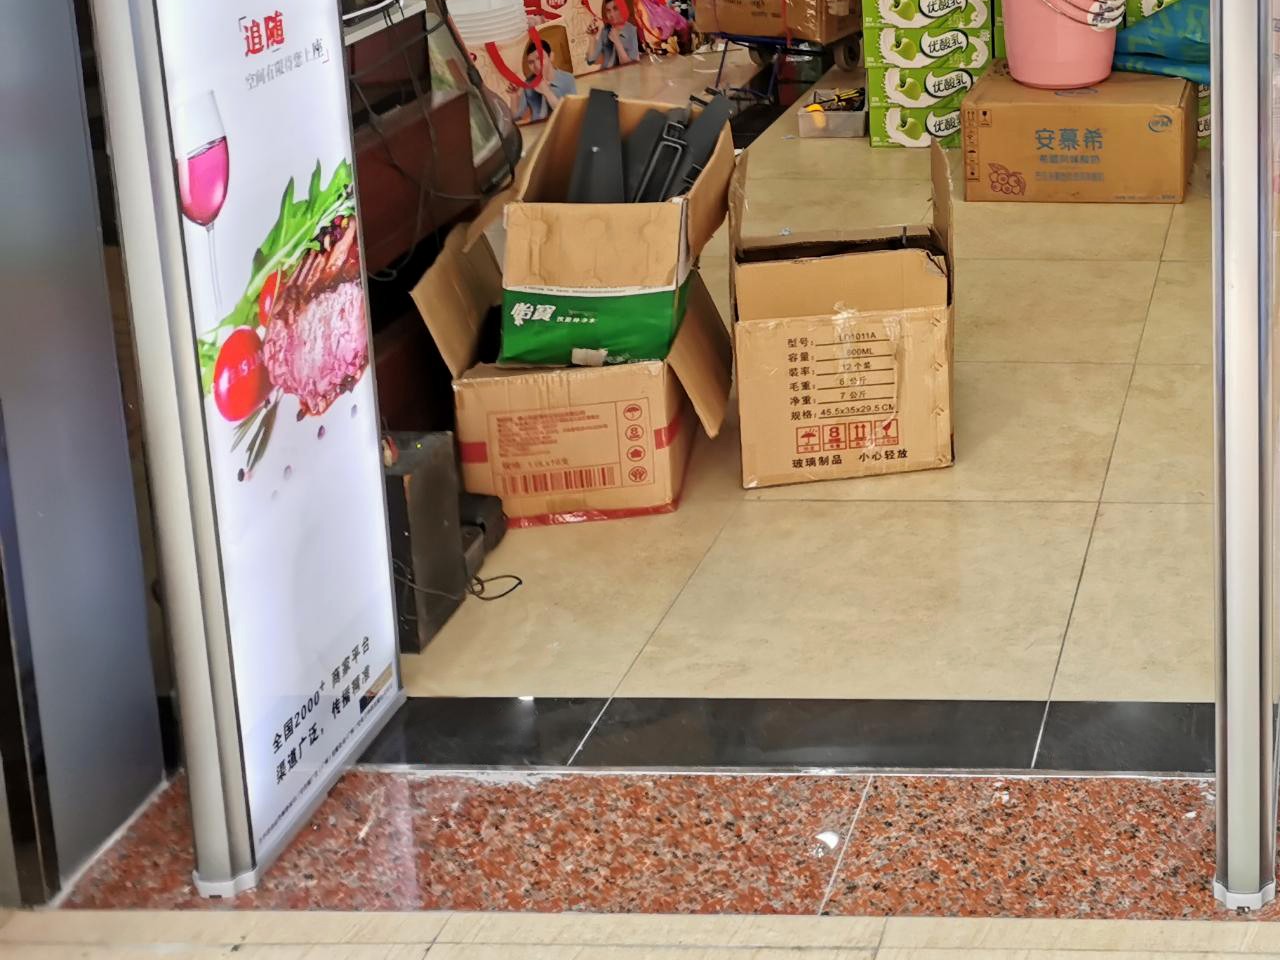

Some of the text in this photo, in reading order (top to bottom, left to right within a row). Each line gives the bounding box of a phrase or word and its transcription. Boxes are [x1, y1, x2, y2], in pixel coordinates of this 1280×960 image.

[243, 10, 285, 57] 追随
[927, 34, 964, 54] 优酸乳
[932, 74, 969, 94] 优酸乳
[1035, 128, 1104, 150] 安慕希
[792, 448, 908, 469] 玻璃制品 小心轻放
